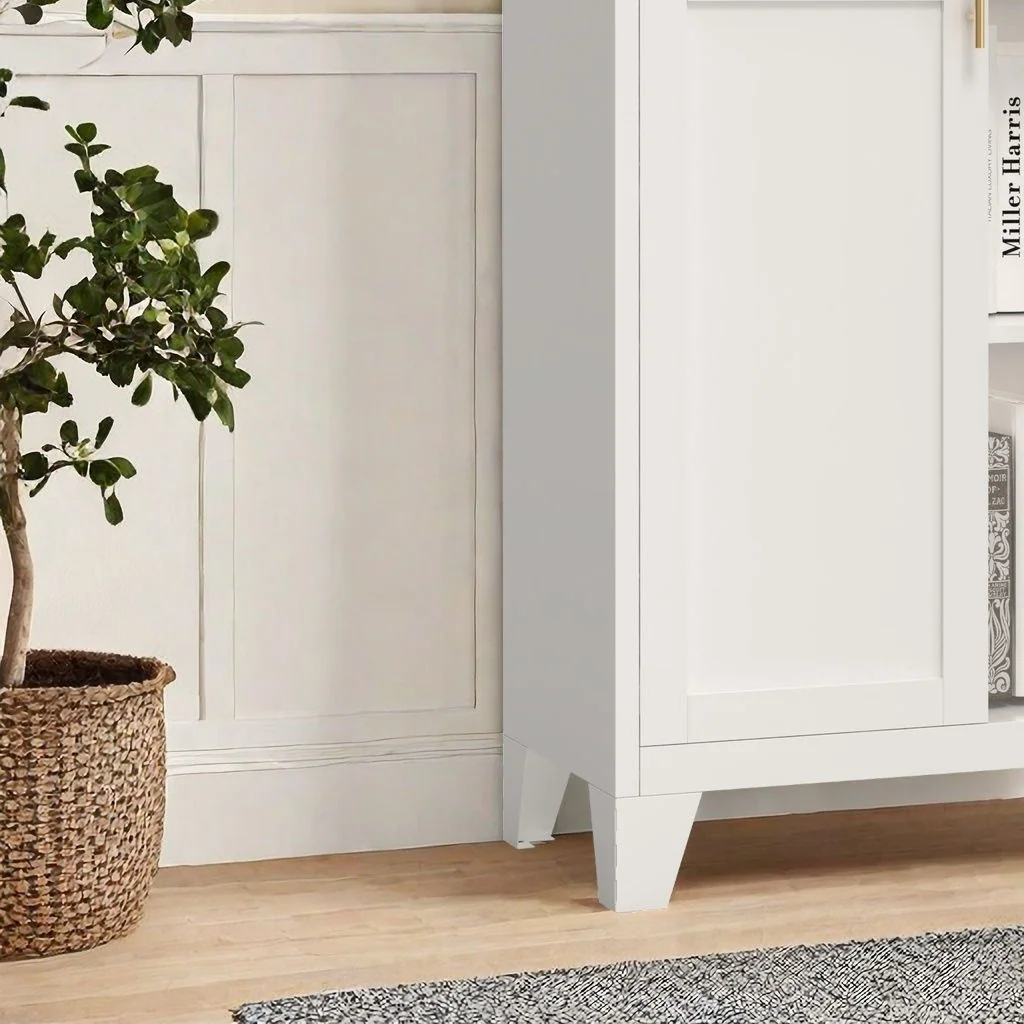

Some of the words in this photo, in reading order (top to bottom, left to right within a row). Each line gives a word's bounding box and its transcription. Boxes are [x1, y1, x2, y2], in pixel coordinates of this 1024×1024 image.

[1002, 96, 1021, 176] Harris
[1002, 183, 1021, 258] Miller
[988, 473, 1007, 482] MOIR
